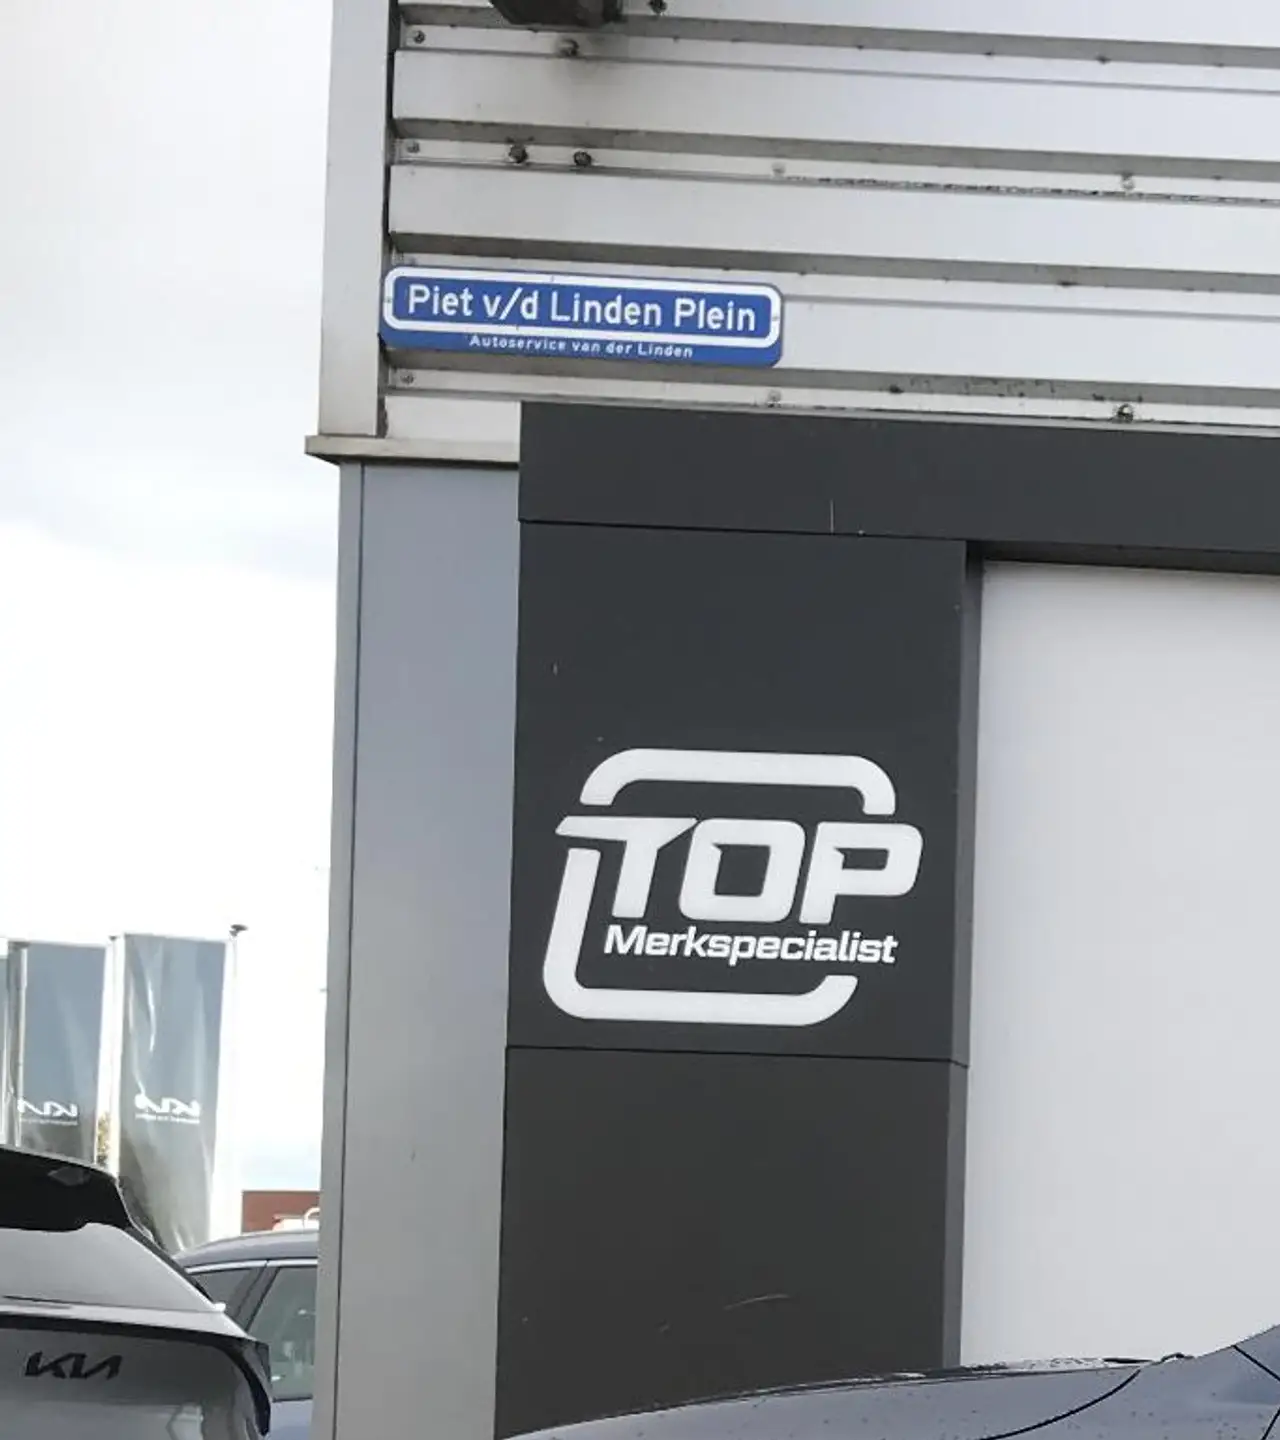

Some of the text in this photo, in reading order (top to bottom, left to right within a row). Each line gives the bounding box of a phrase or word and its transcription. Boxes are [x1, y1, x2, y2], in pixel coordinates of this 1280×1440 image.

[407, 284, 756, 332] Piet v/d Linden Plein
[469, 335, 694, 359] Autoservice van der Linden
[555, 815, 923, 924] TOP
[603, 924, 899, 966] Merkspecialist
[25, 1351, 123, 1380] KIA
